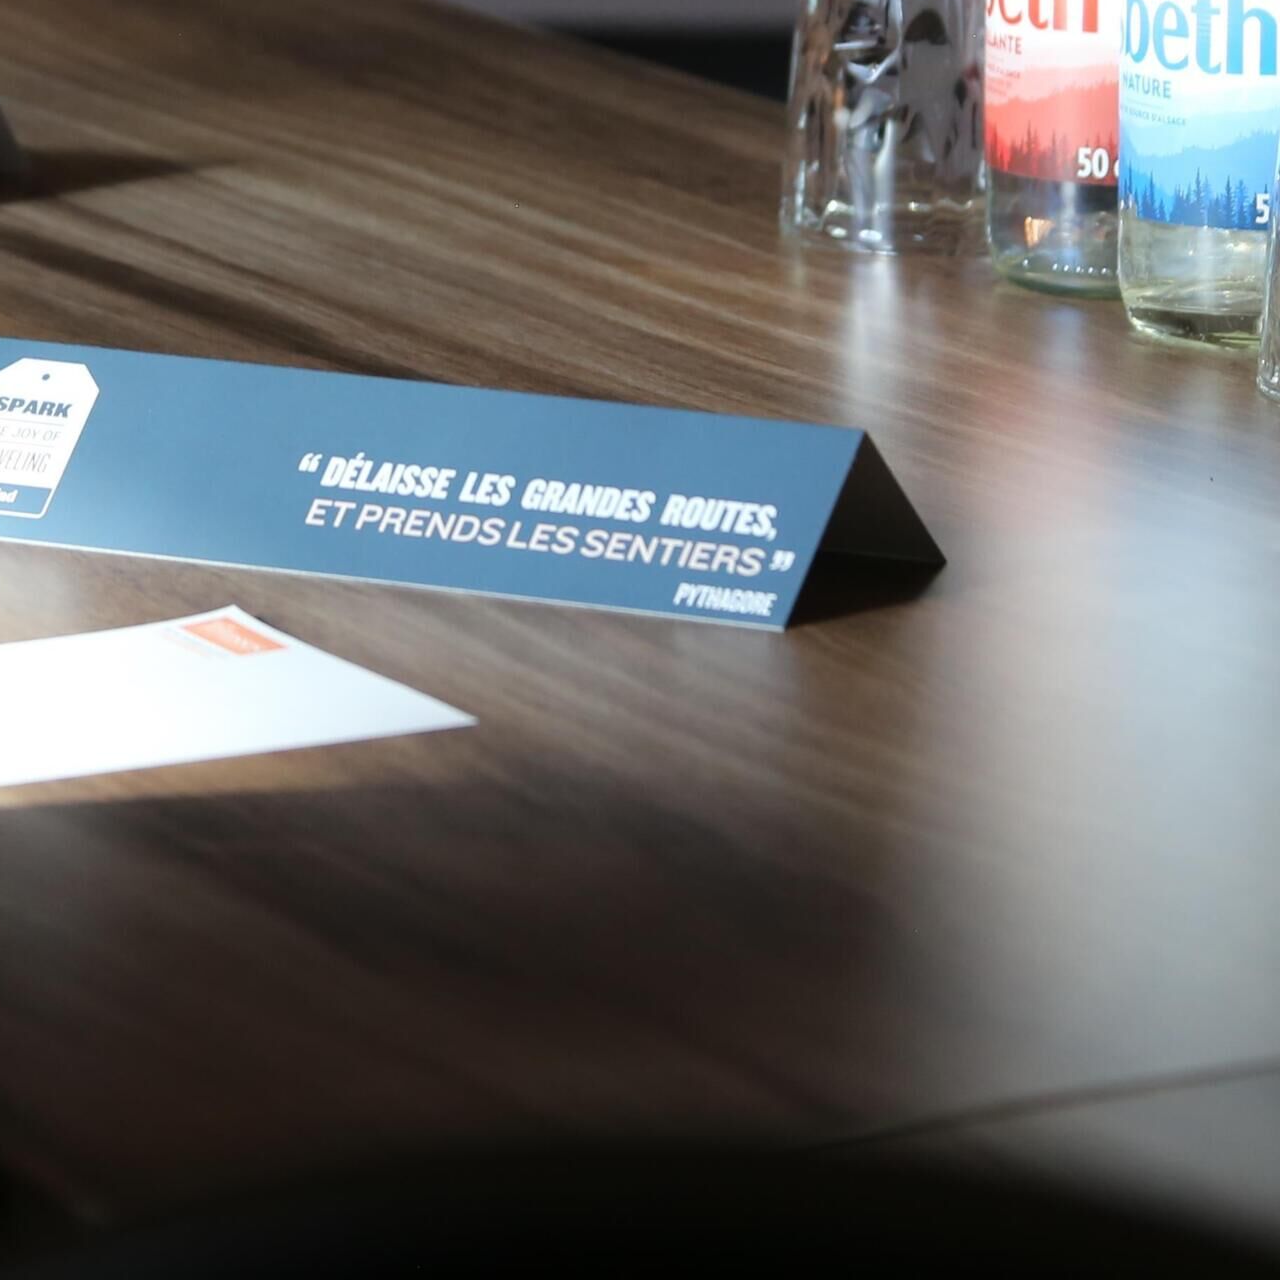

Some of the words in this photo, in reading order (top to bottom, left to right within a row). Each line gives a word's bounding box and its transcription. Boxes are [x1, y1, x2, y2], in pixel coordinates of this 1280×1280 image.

[10, 425, 41, 441] JOY
[42, 429, 63, 443] OF
[305, 498, 358, 528] ET
[354, 503, 507, 547] PRENDS
[506, 520, 581, 556] LES
[459, 471, 517, 507] LES
[520, 477, 657, 524] GRANDES
[659, 493, 778, 542] ROUTES,
[672, 582, 778, 617] PYTHAGORE
